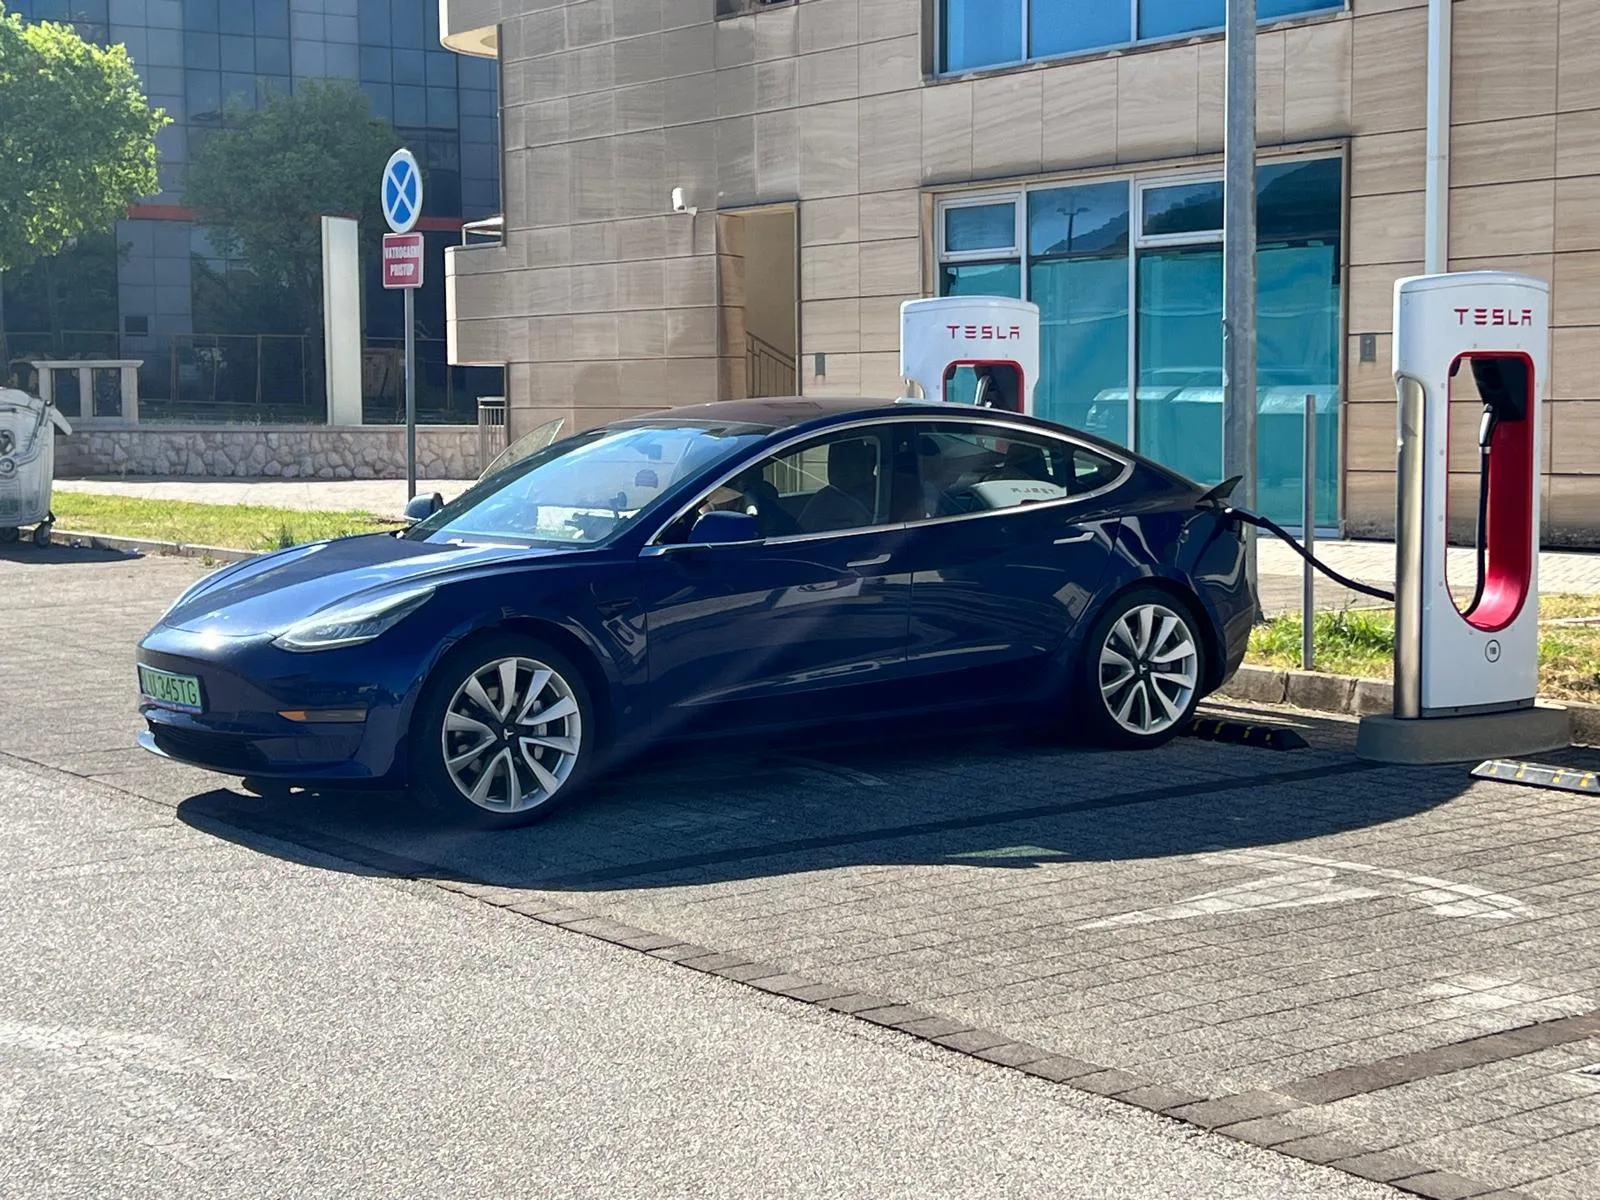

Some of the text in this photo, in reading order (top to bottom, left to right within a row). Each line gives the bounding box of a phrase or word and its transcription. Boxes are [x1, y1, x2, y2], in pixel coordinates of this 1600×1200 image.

[390, 263, 414, 276] PRISTUP
[1454, 308, 1532, 326] TESLA
[946, 325, 1020, 339] TESLA
